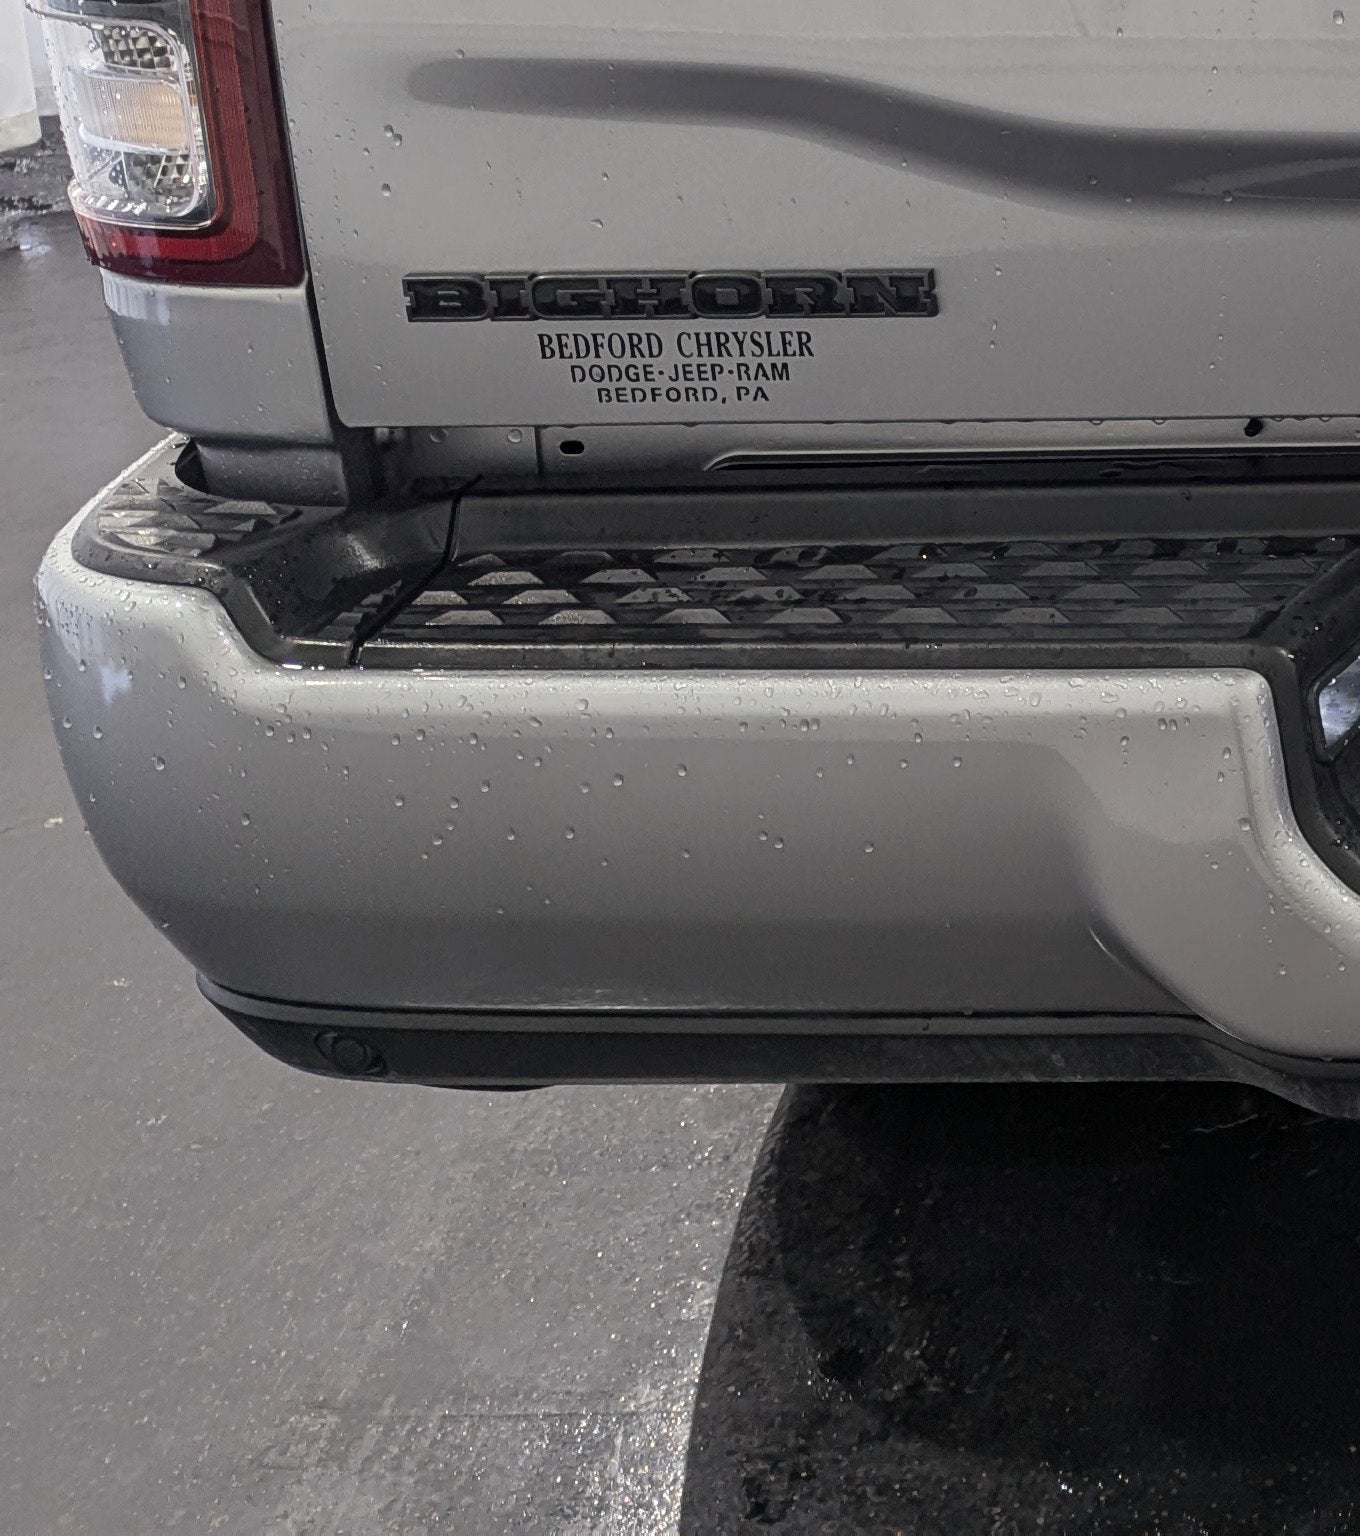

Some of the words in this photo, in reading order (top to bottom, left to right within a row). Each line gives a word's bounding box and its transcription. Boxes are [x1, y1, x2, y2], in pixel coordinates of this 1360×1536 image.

[536, 332, 663, 360] BEDFORD
[676, 330, 814, 360] CHRYSLER
[597, 387, 727, 405] BEDFORD,
[736, 387, 770, 403] PA
